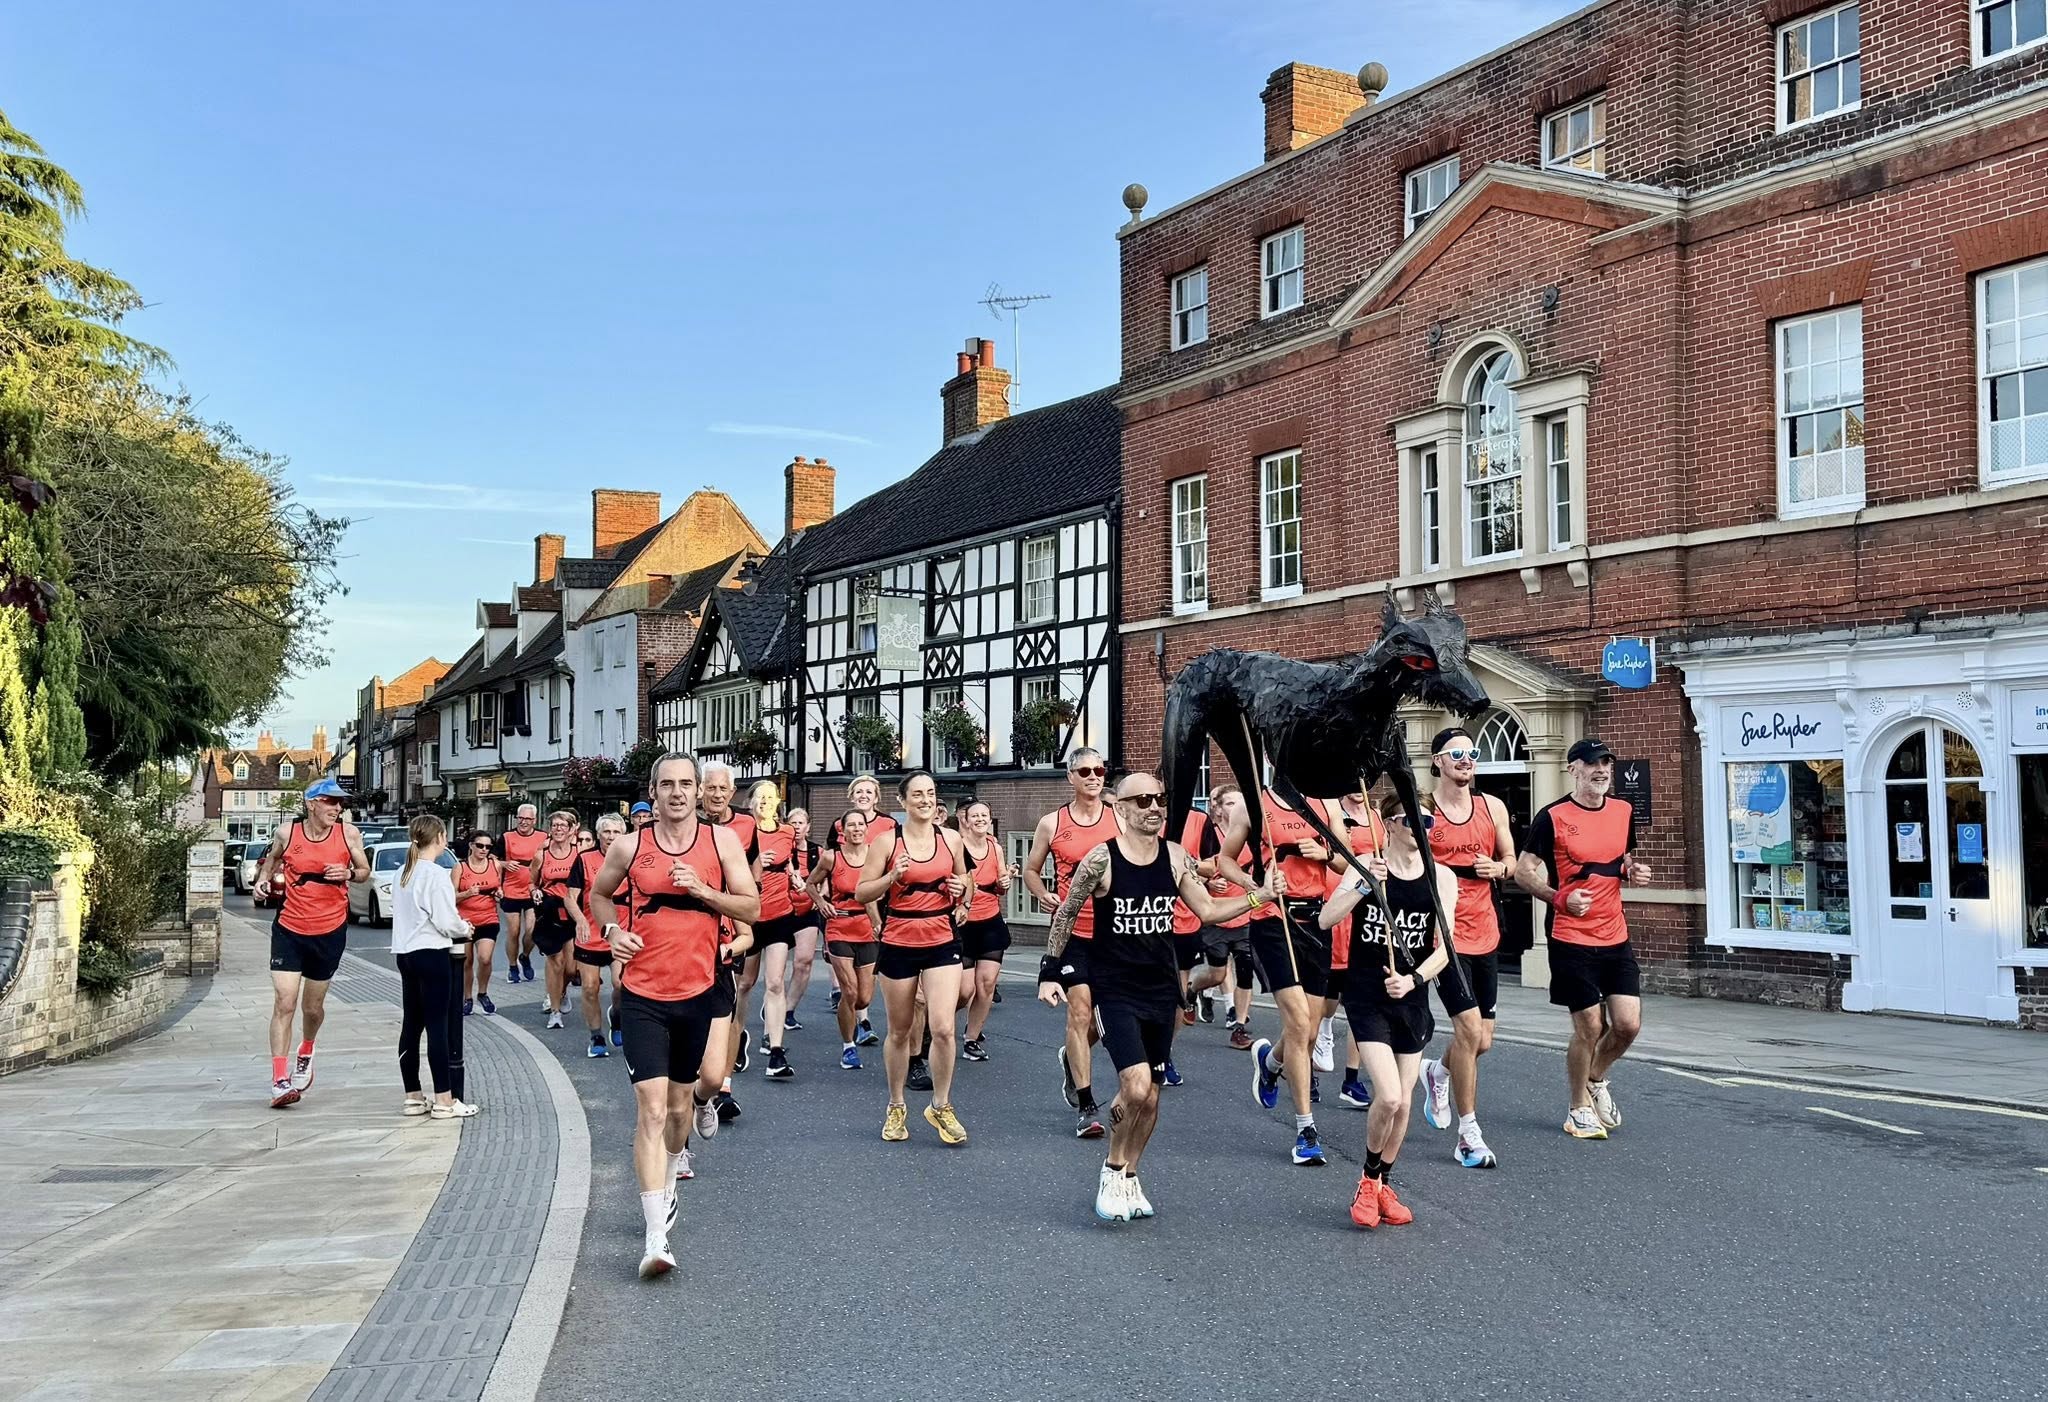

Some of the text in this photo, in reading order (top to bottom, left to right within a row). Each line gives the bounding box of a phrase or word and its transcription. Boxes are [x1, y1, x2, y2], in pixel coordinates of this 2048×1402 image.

[1607, 651, 1648, 676] Sue Ryder
[2035, 705, 2048, 716] in
[1741, 711, 1822, 749] Sue Ryder
[1750, 775, 1765, 784] Gift
[1766, 775, 1777, 784] Aid
[1446, 843, 1481, 854] MARGO
[1113, 895, 1176, 915] BLACK
[1112, 915, 1174, 935] SHUCK
[1364, 904, 1430, 930] BLACK
